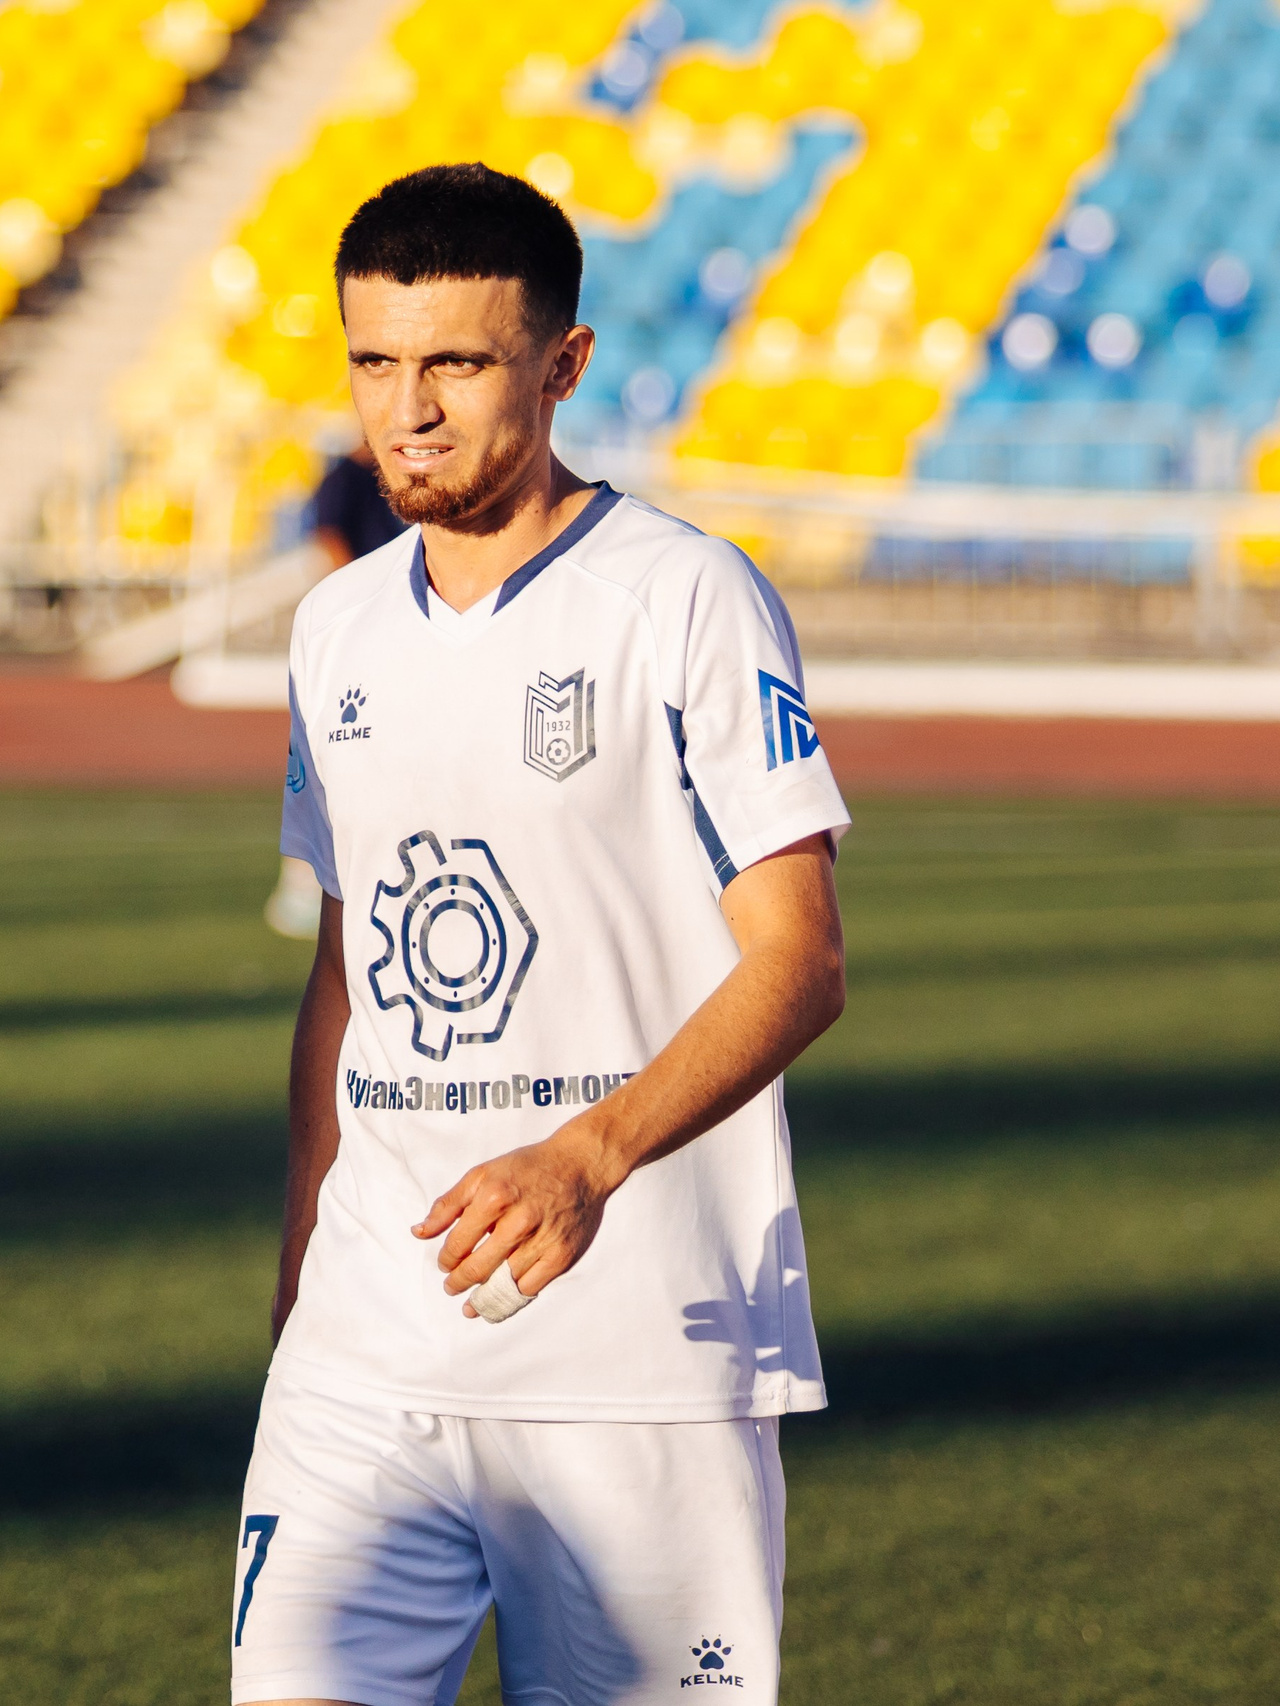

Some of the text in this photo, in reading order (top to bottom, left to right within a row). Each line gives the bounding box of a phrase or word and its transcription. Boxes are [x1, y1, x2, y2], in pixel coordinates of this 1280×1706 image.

[546, 720, 571, 732] 1932
[328, 727, 372, 743] KELME
[234, 1515, 280, 1648] 7
[680, 1673, 744, 1688] KELME
